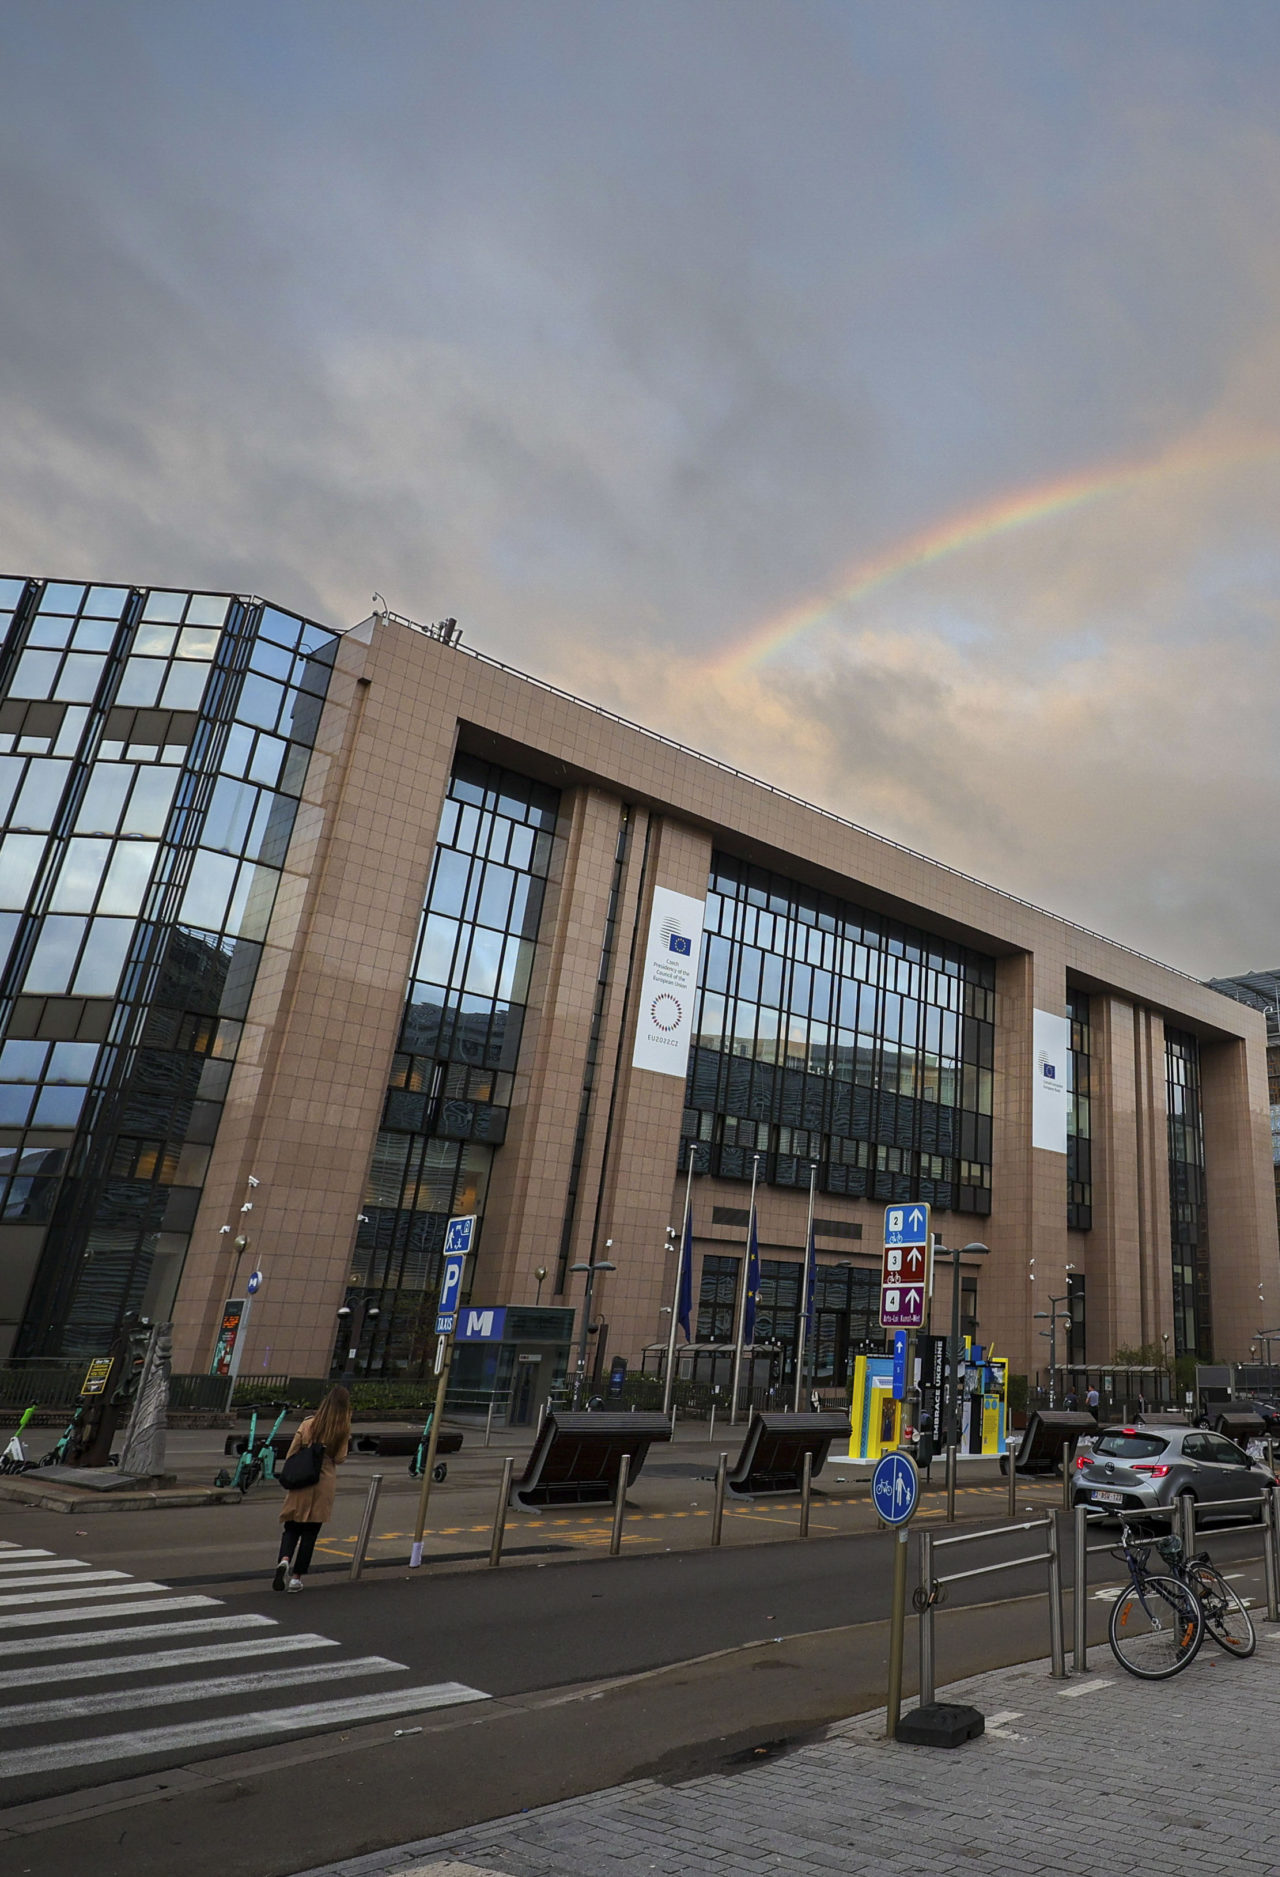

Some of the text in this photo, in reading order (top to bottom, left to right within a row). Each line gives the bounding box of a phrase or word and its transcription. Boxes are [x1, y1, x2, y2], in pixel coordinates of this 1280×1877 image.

[653, 961, 677, 974] Presidency
[656, 969, 673, 979] Council
[652, 975, 687, 989] European Union
[893, 1216, 899, 1226] 2
[892, 1255, 897, 1265] 3
[441, 1263, 460, 1305] P
[889, 1296, 895, 1305] 4
[437, 1317, 453, 1331] TAXIS
[466, 1310, 494, 1337] M
[935, 1340, 943, 1387] UKRAINE
[933, 1389, 941, 1441] EMBRACE
